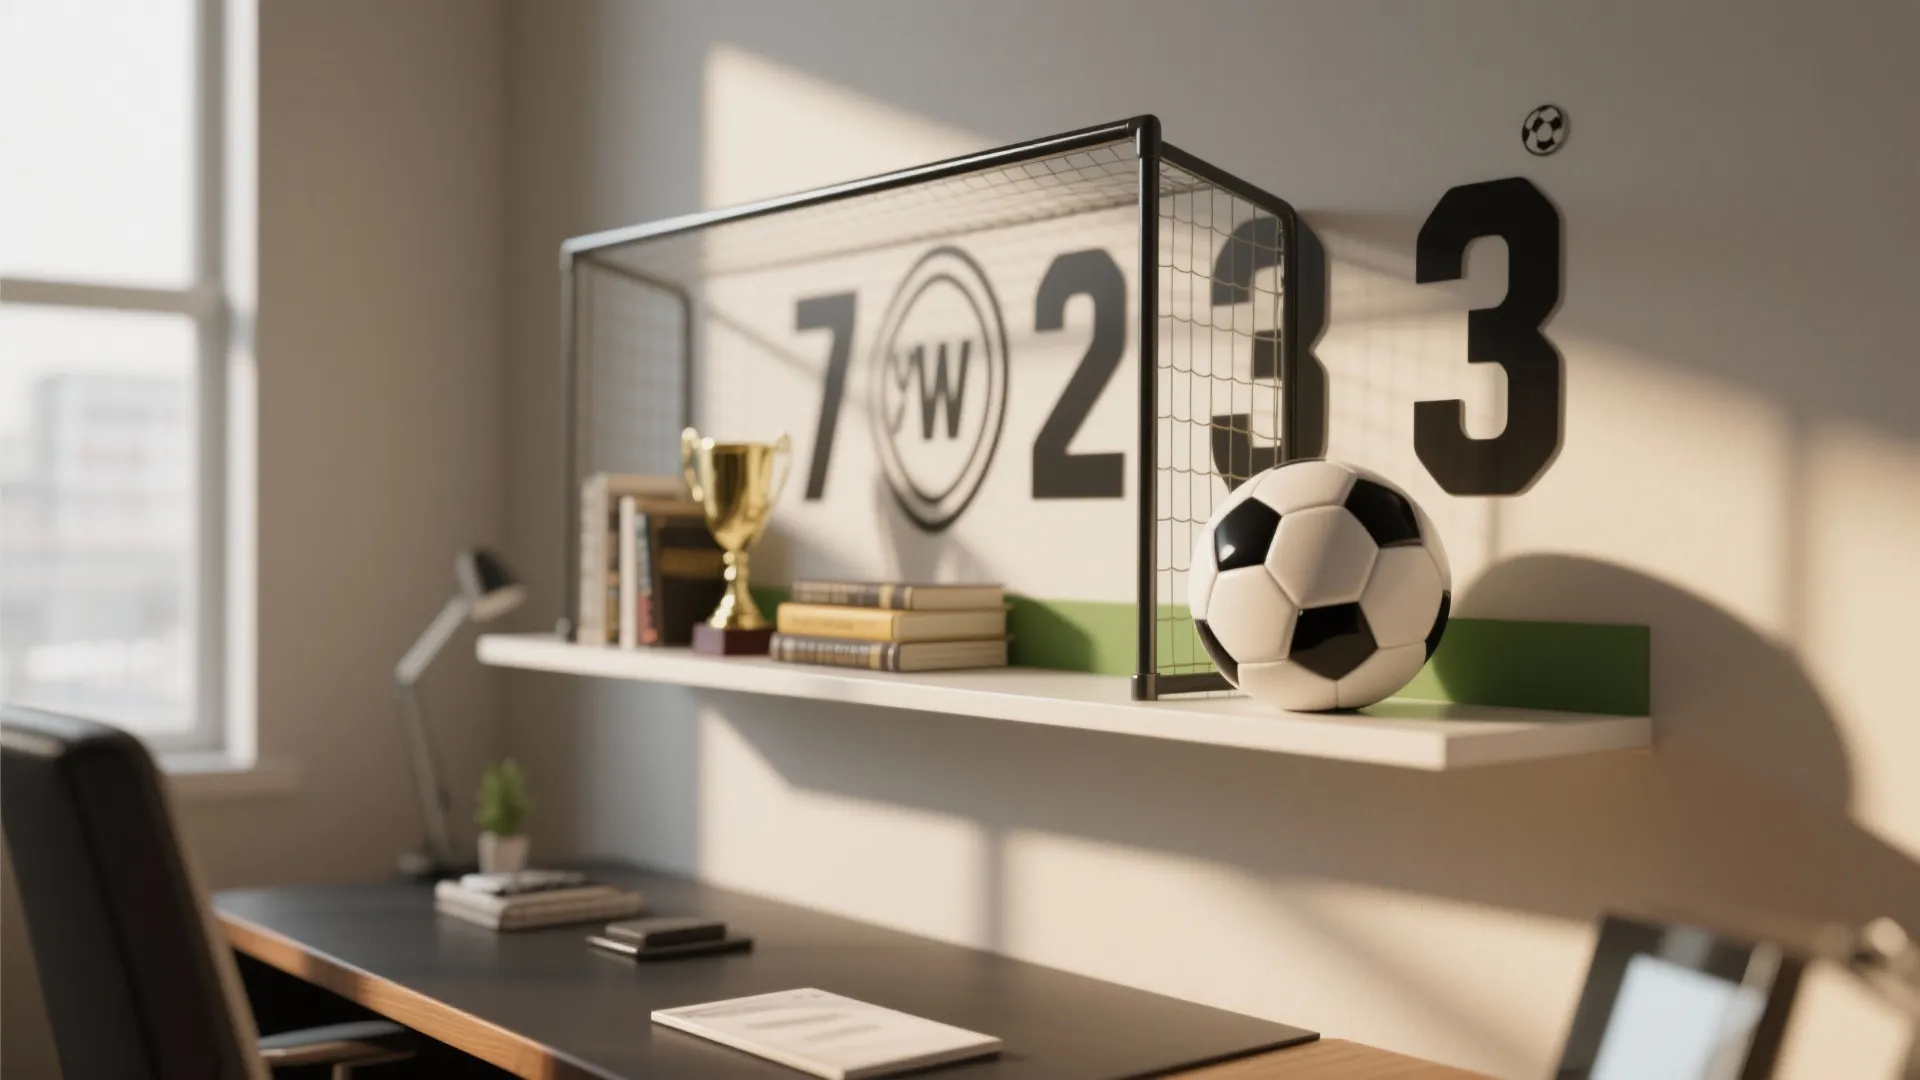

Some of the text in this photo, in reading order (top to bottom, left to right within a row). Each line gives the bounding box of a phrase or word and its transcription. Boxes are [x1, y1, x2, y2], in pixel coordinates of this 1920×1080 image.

[1033, 248, 1127, 499] 2
[1211, 215, 1329, 494] 3
[1414, 176, 1562, 496] 3
